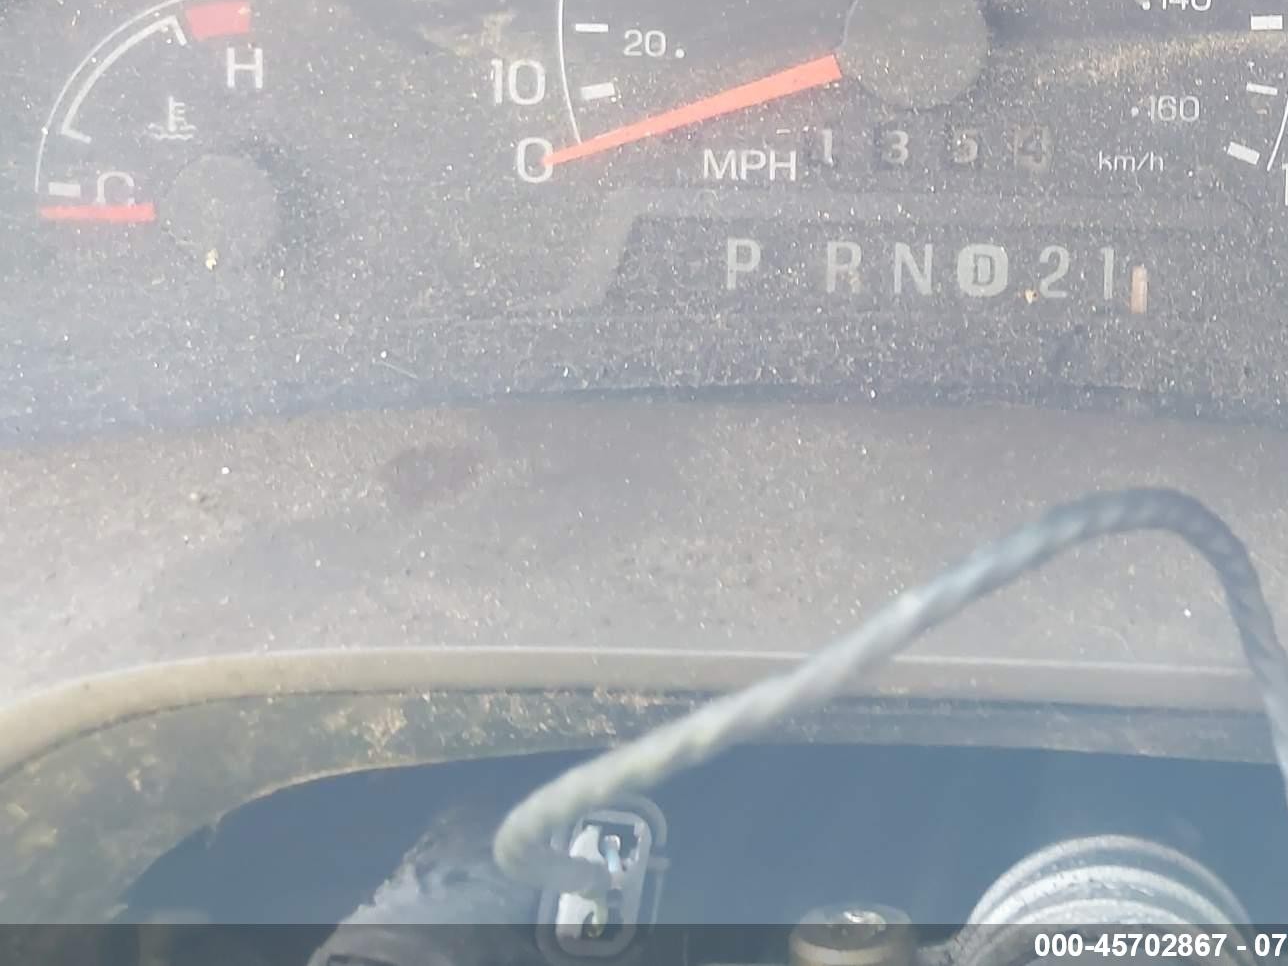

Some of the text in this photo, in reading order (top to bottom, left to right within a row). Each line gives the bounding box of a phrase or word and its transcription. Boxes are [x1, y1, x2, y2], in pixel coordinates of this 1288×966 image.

[623, 30, 667, 57] 20
[226, 47, 263, 89] H
[490, 59, 546, 105] 10
[1149, 95, 1200, 123] 160
[515, 137, 554, 183] 0
[702, 149, 797, 180] MPH
[1099, 151, 1164, 172] km/h
[726, 238, 761, 290] P
[826, 241, 862, 294] R
[894, 242, 933, 295] N
[1039, 246, 1070, 298] 2
[1103, 248, 1115, 300] 1
